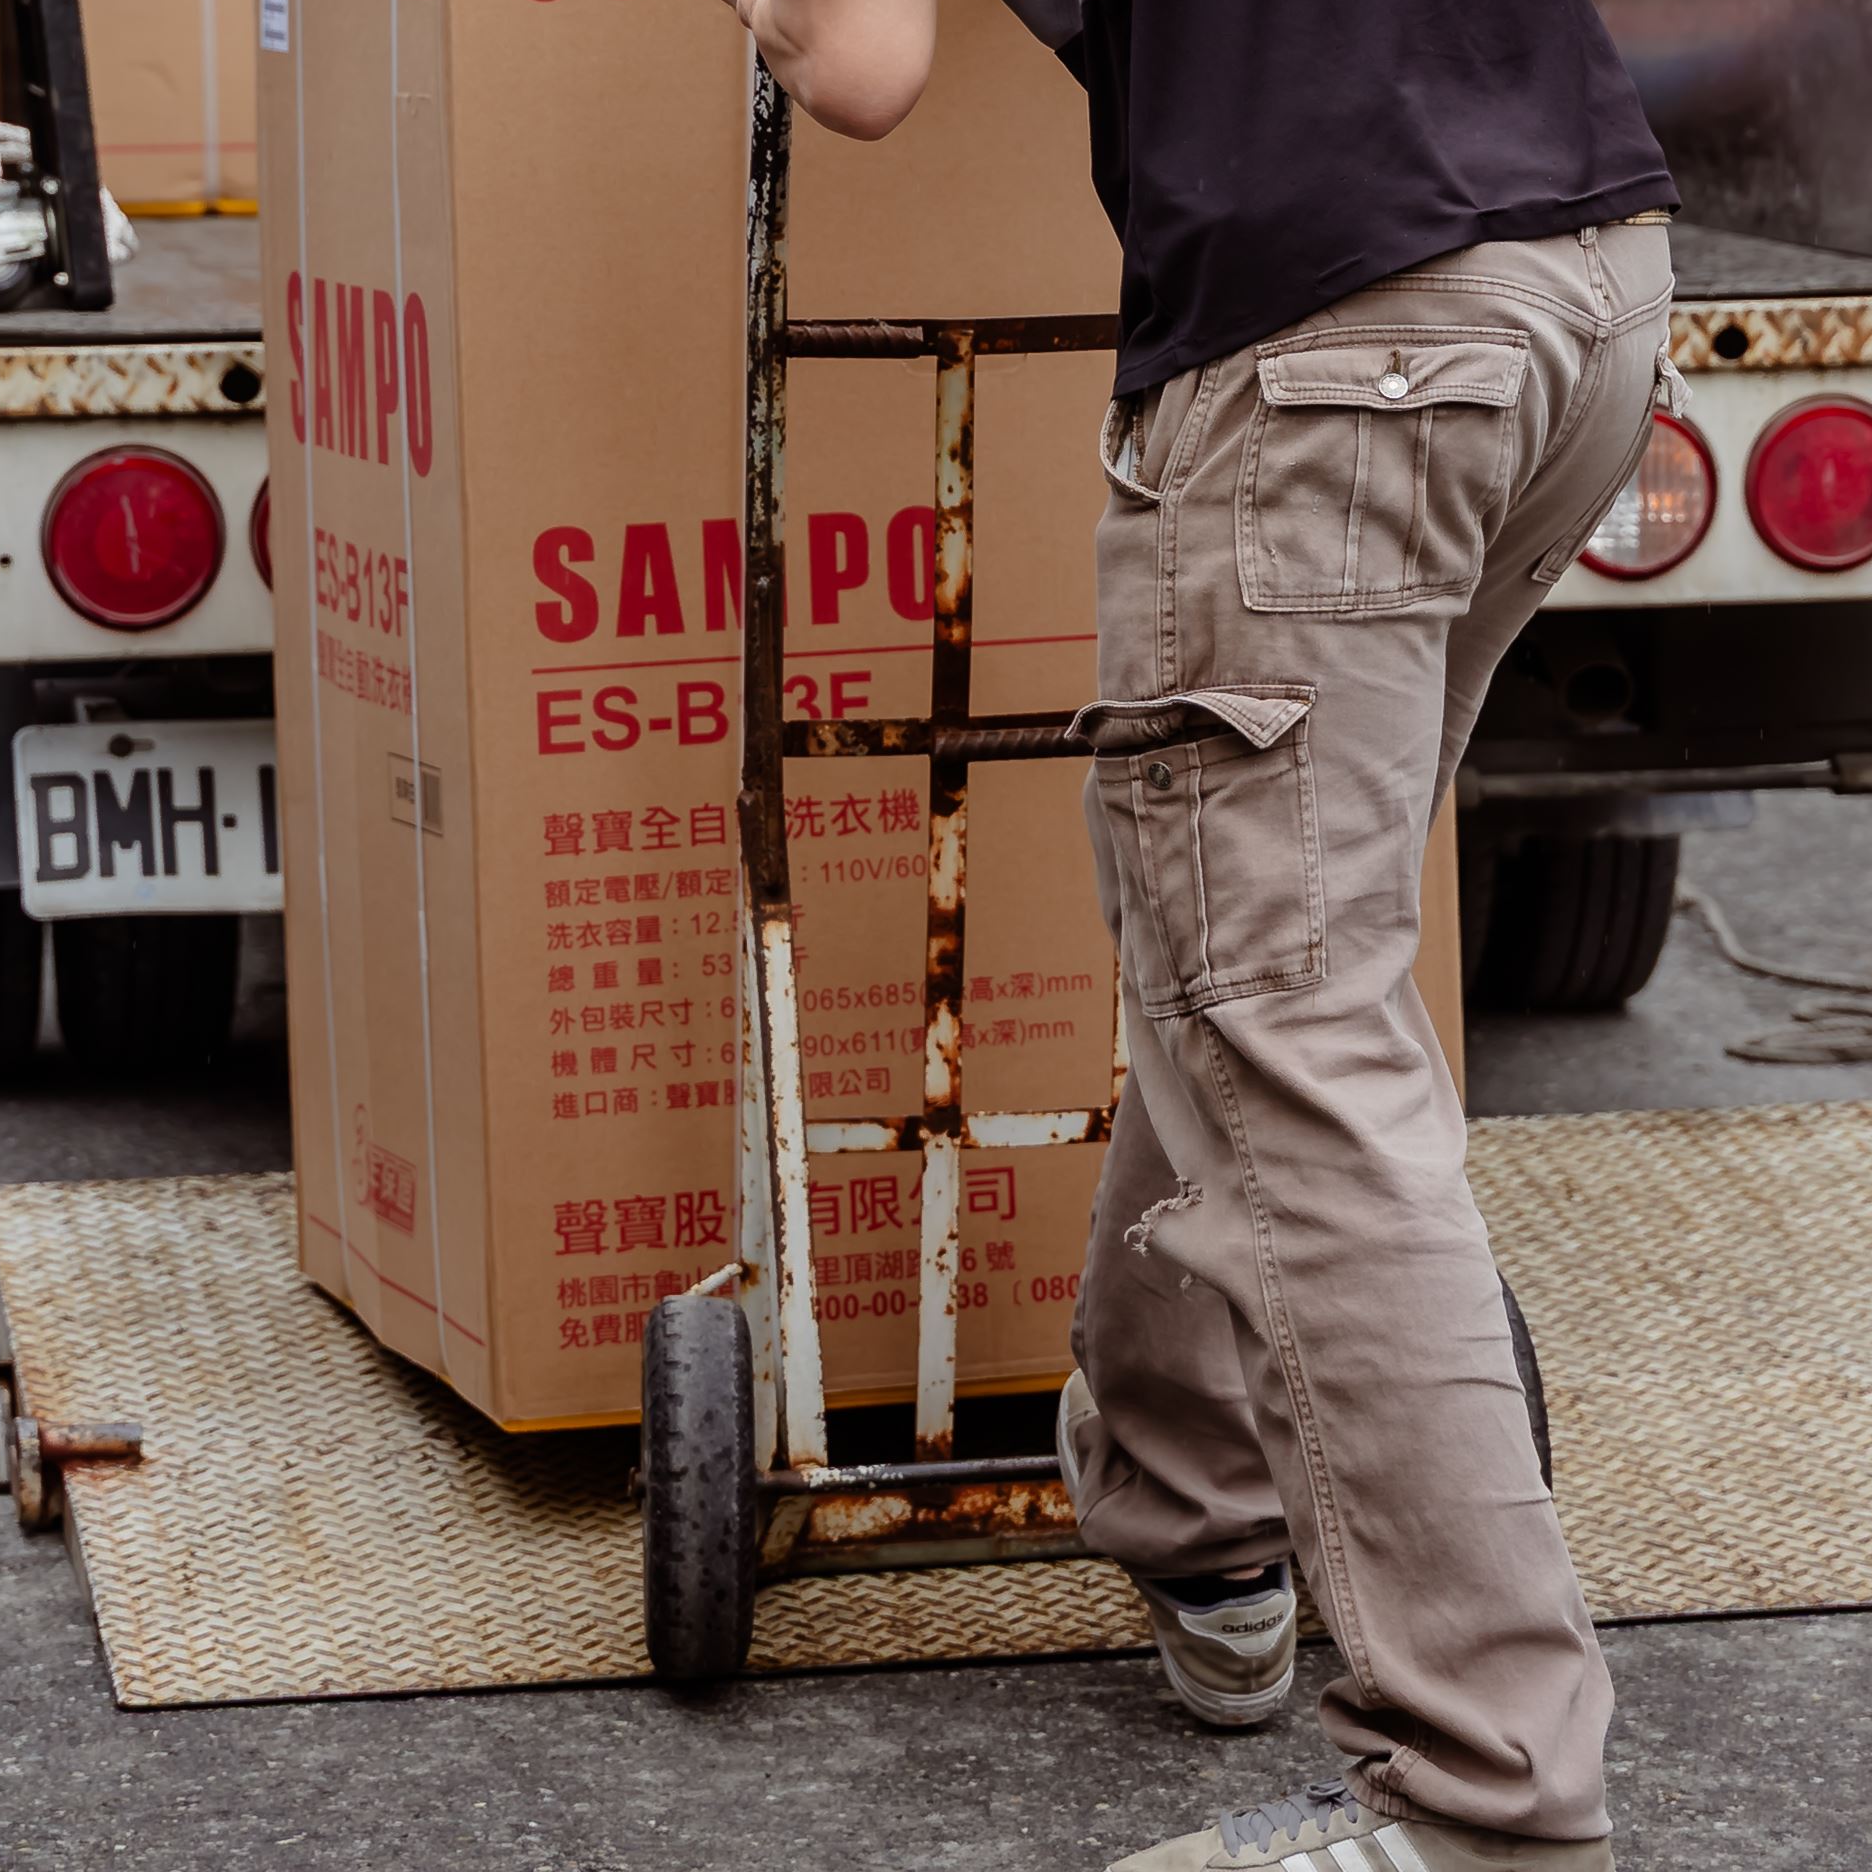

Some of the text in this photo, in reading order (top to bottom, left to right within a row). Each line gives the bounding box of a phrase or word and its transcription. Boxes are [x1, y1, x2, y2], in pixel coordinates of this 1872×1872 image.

[287, 270, 433, 478] SAMPO
[315, 528, 410, 640] ES-B13F
[536, 670, 872, 755] ES-B3F
[543, 788, 921, 856] 聲寶全自洗衣機
[553, 1166, 1017, 1257] 聲寶股有限司
[1221, 1609, 1285, 1634] adidas
